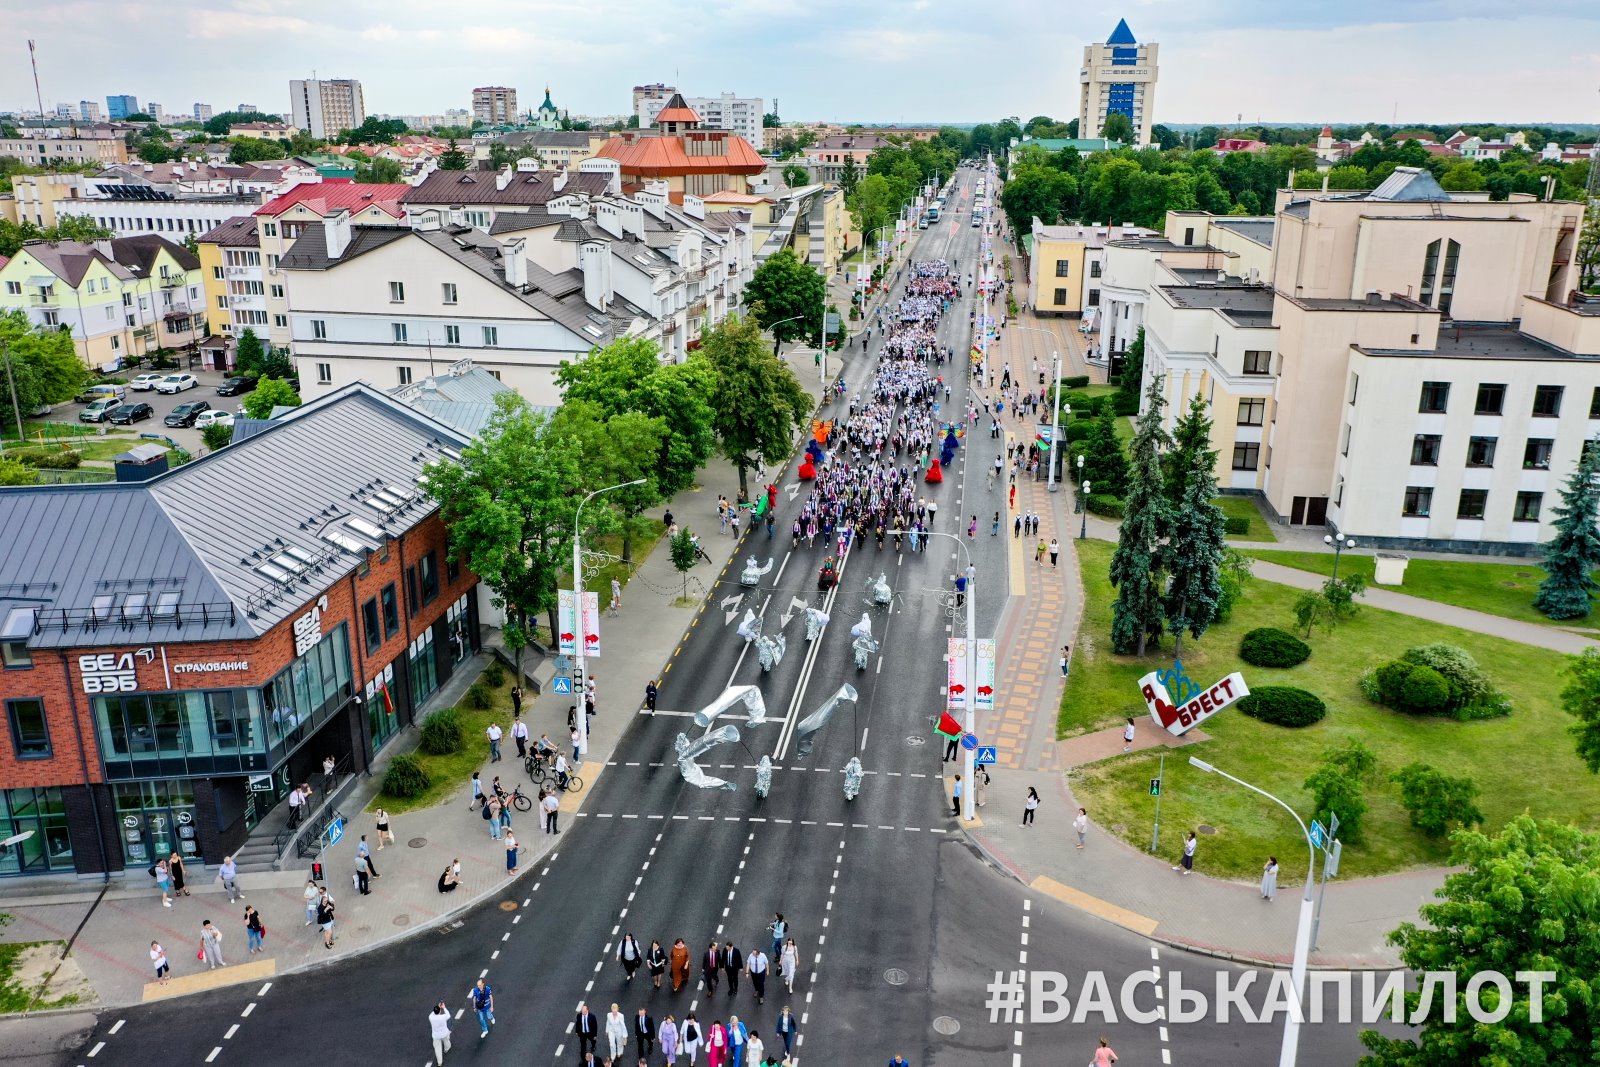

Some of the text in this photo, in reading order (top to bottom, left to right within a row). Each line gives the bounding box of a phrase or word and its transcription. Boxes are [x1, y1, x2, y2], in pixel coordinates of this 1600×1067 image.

[293, 606, 320, 636] БЕЛ
[295, 626, 322, 657] ВЭБ
[78, 653, 135, 672] БЕЛ
[173, 661, 249, 674] СТРАХОВАНИЕ
[82, 675, 138, 693] ВЭБ
[1142, 678, 1234, 728] Я БРЕСТ
